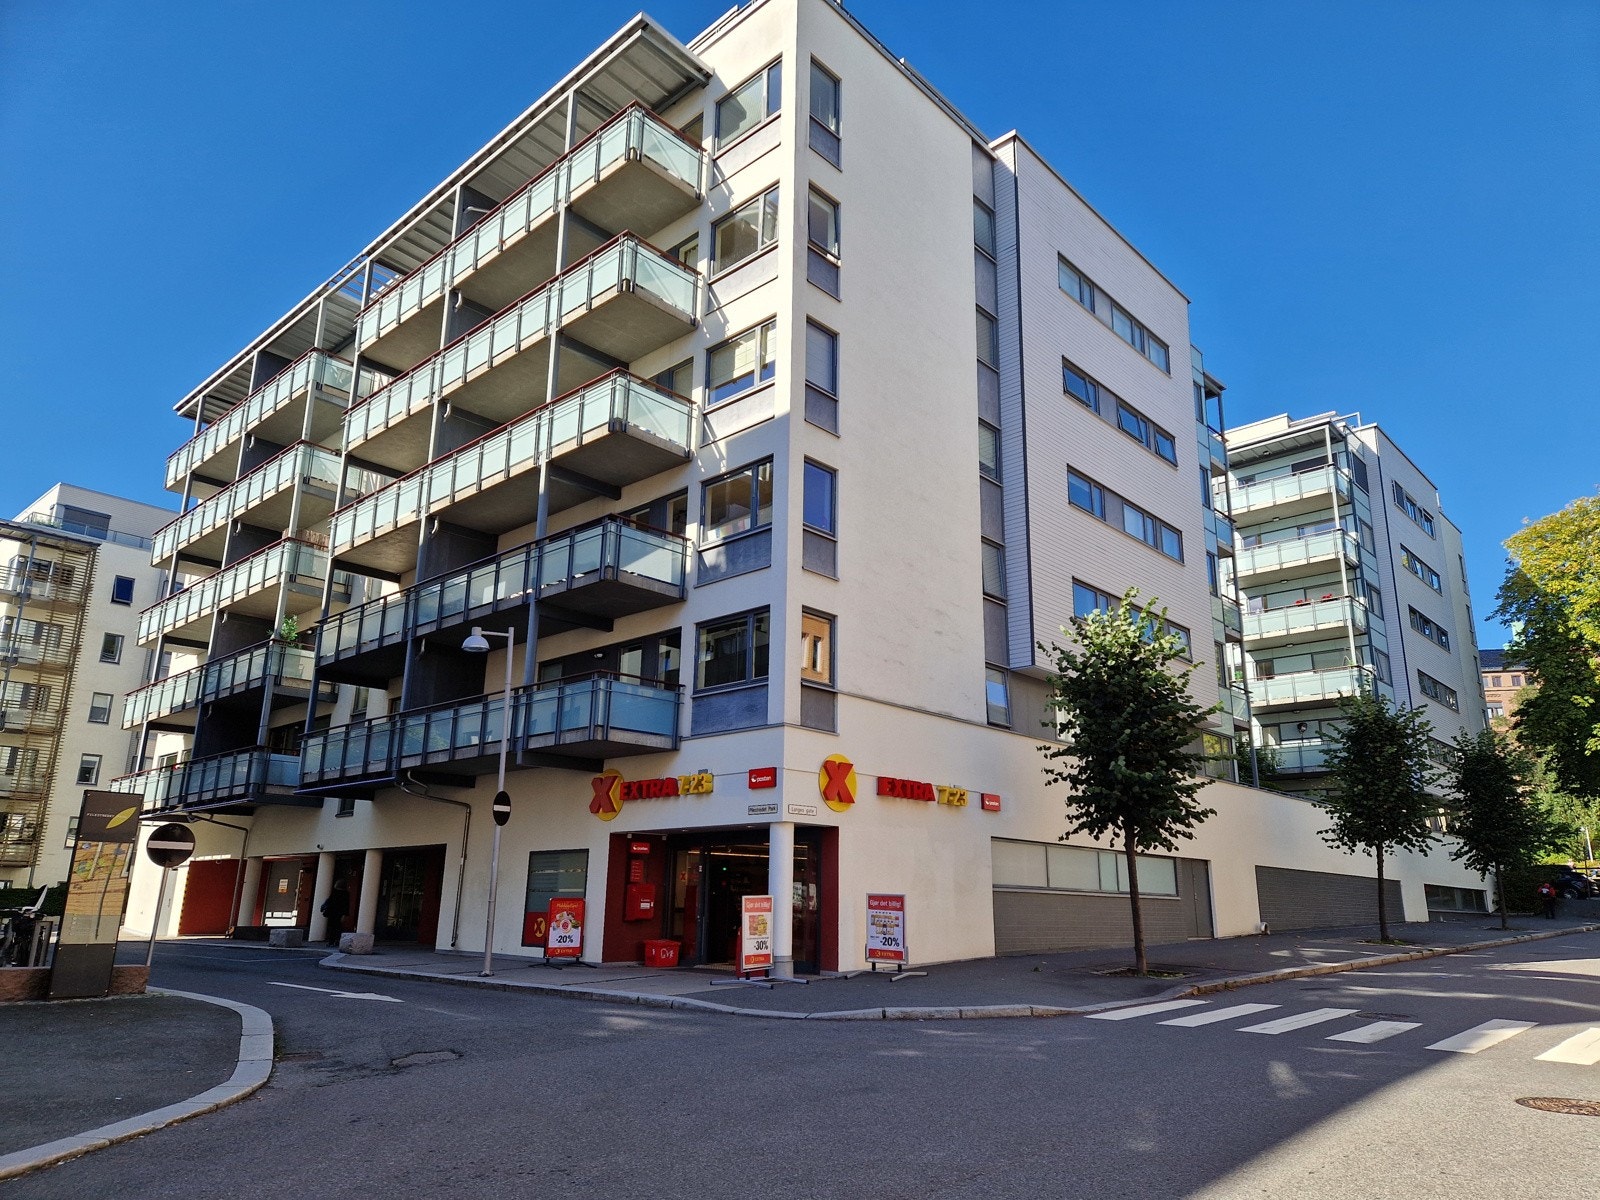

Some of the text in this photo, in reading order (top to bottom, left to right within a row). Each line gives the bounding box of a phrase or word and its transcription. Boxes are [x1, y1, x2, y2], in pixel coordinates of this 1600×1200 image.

[756, 775, 772, 783] posten
[619, 773, 713, 801] EXTRA 7-23
[877, 776, 969, 807] EXTRA 7-23
[556, 935, 574, 944] -20%
[880, 936, 900, 947] -20%
[754, 940, 769, 951] -30%
